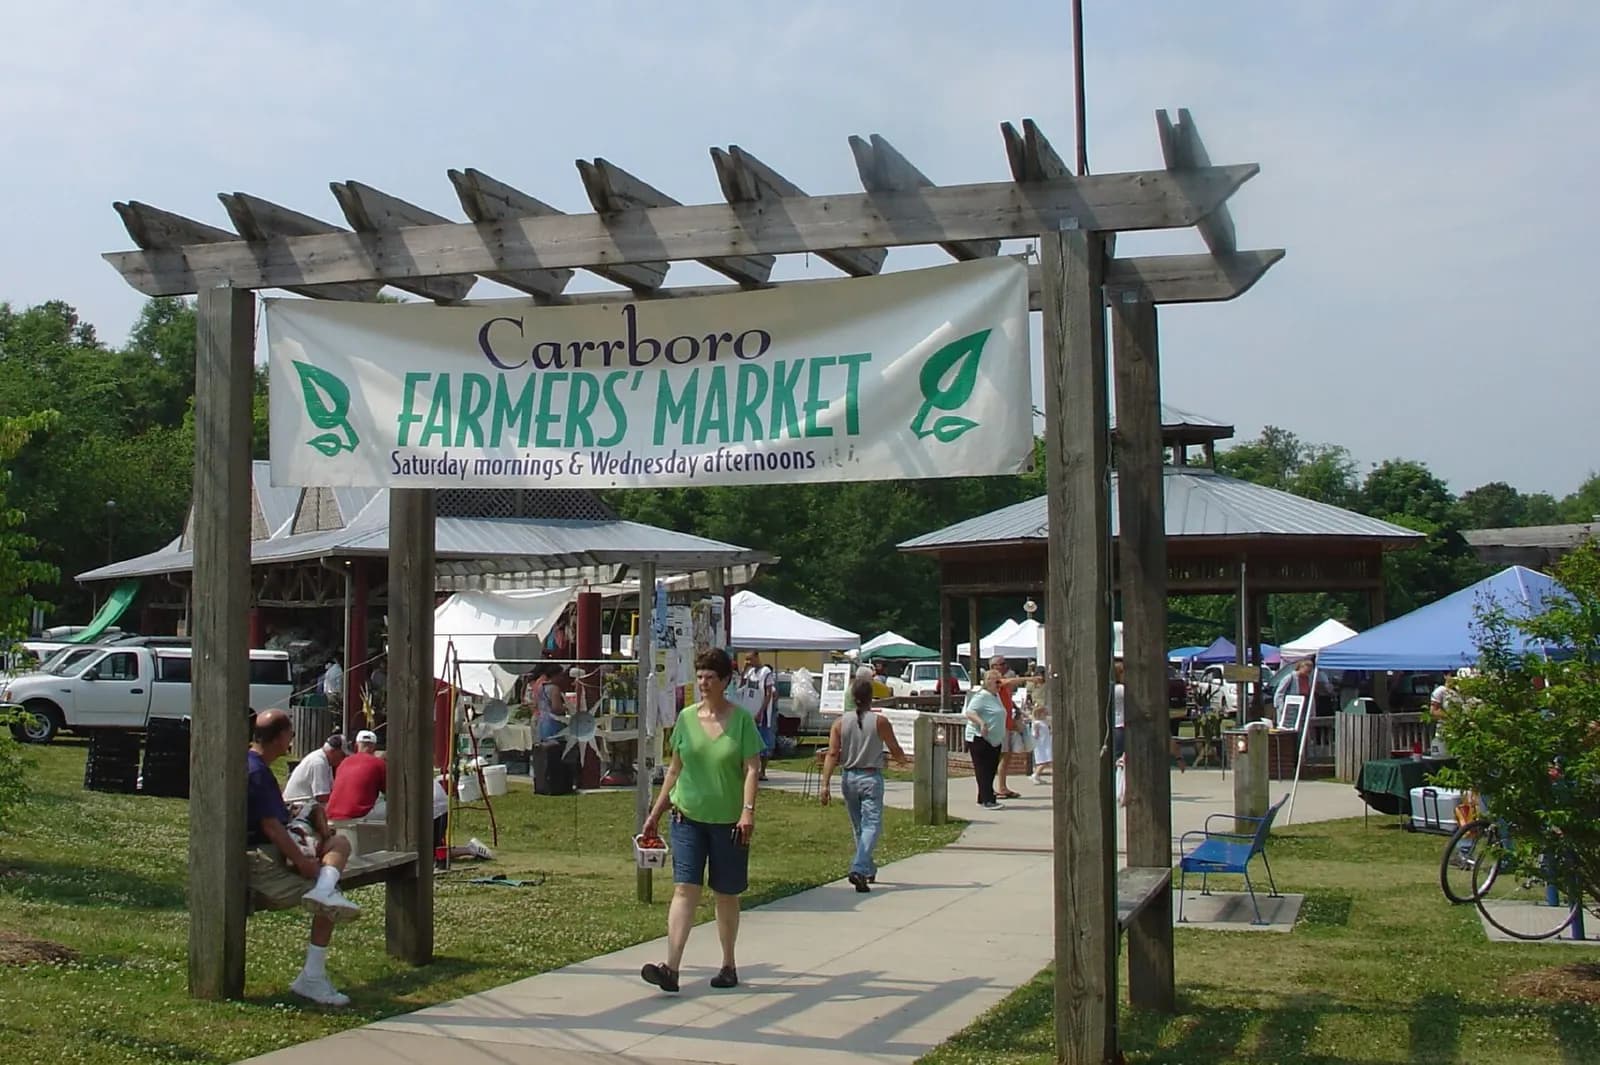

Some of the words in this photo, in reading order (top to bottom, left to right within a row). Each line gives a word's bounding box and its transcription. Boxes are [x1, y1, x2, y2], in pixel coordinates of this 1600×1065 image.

[478, 304, 771, 369] Carrboro
[397, 370, 643, 448] FARMERS'
[653, 352, 872, 446] MARKET
[391, 450, 468, 480] Saturday
[474, 453, 563, 480] mornings
[569, 451, 584, 475] &
[590, 448, 699, 478] Wednesday
[703, 446, 816, 473] afternoons
